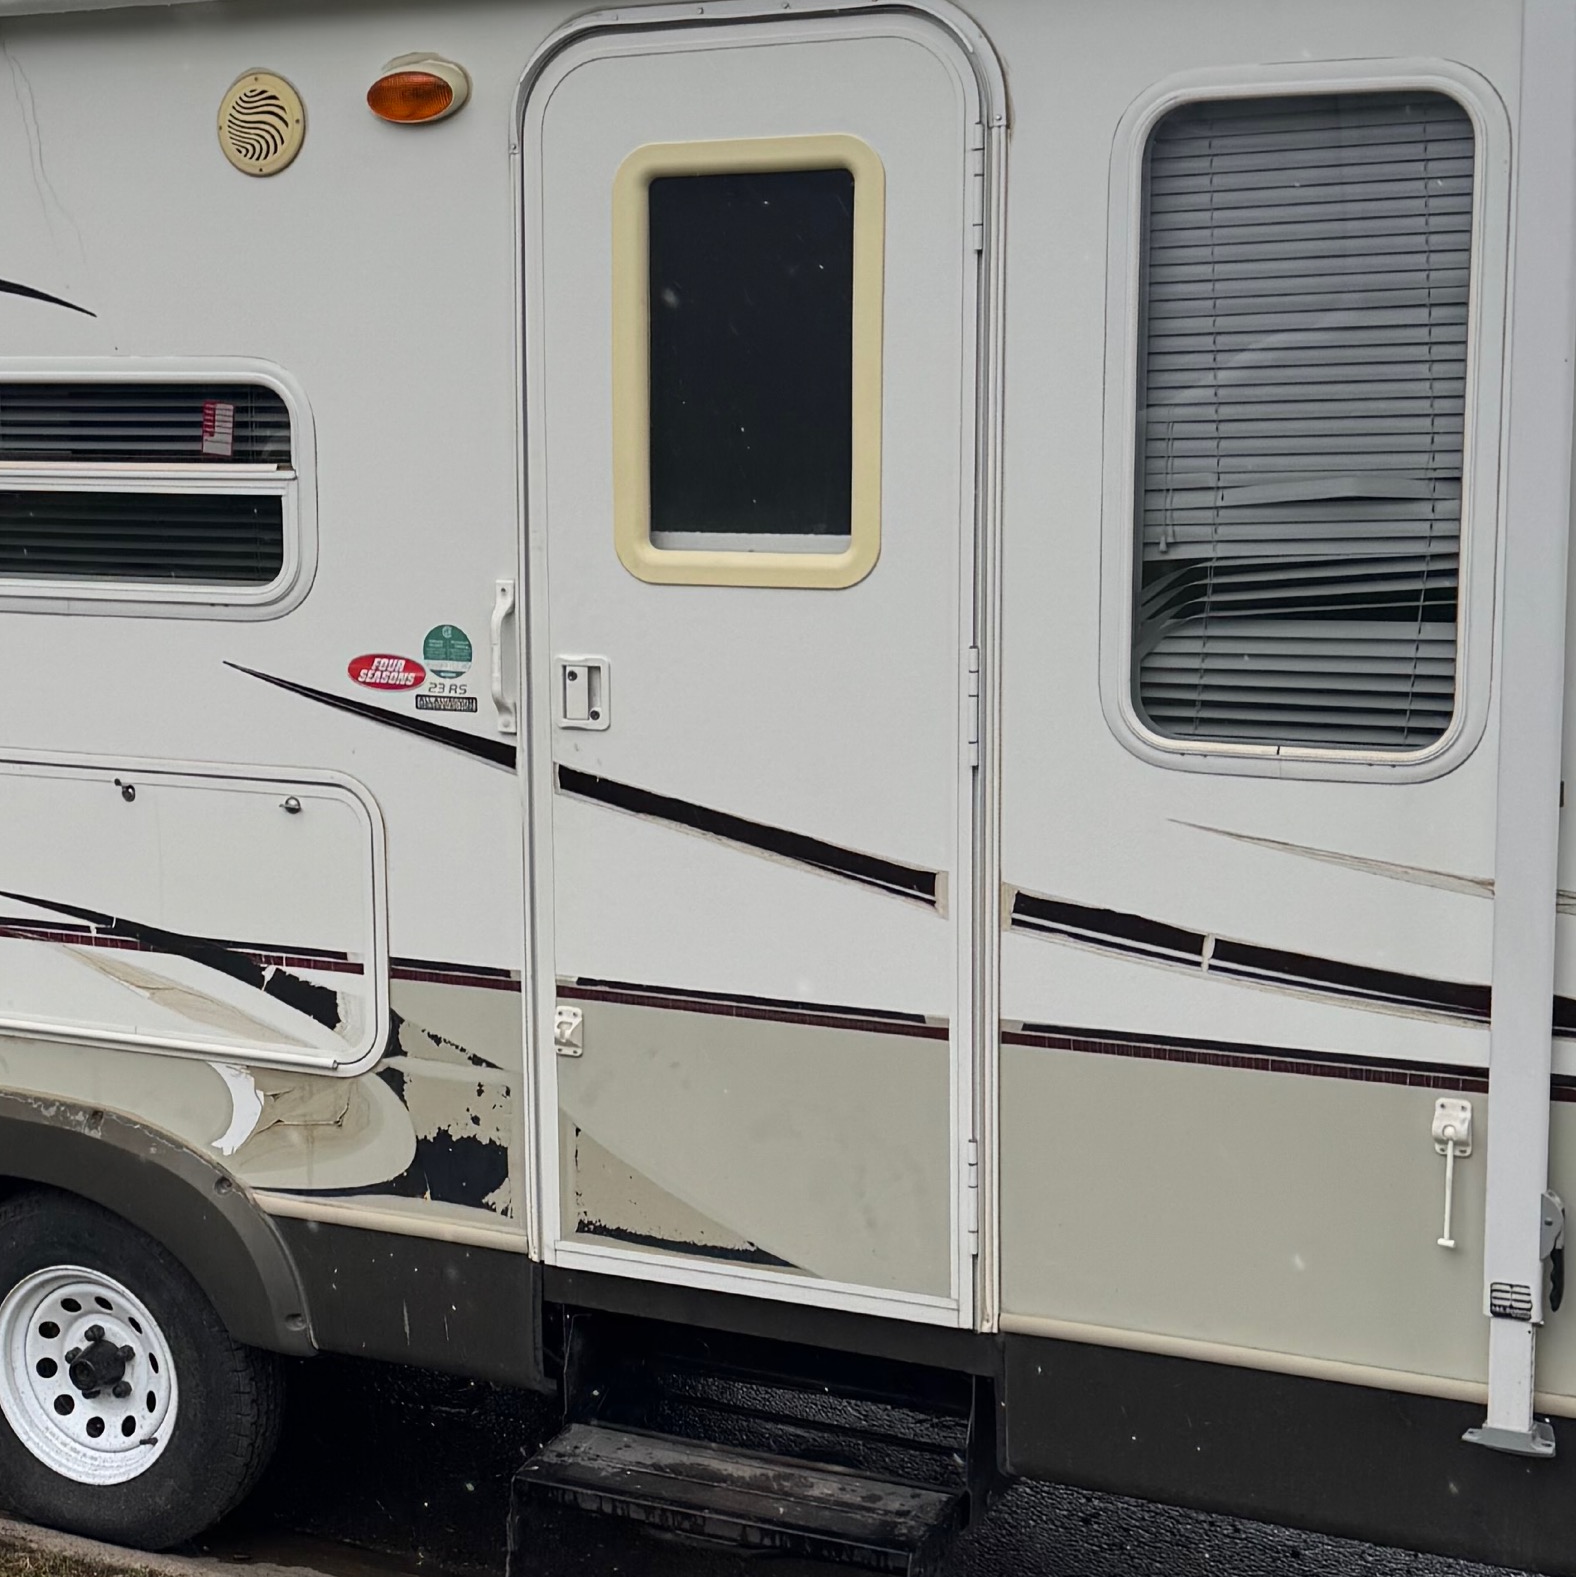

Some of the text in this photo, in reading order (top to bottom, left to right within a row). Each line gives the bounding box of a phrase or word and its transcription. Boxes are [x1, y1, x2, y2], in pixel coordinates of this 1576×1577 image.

[371, 657, 407, 672] FOUR
[357, 668, 416, 686] SEASONS
[428, 682, 468, 695] 23 RS
